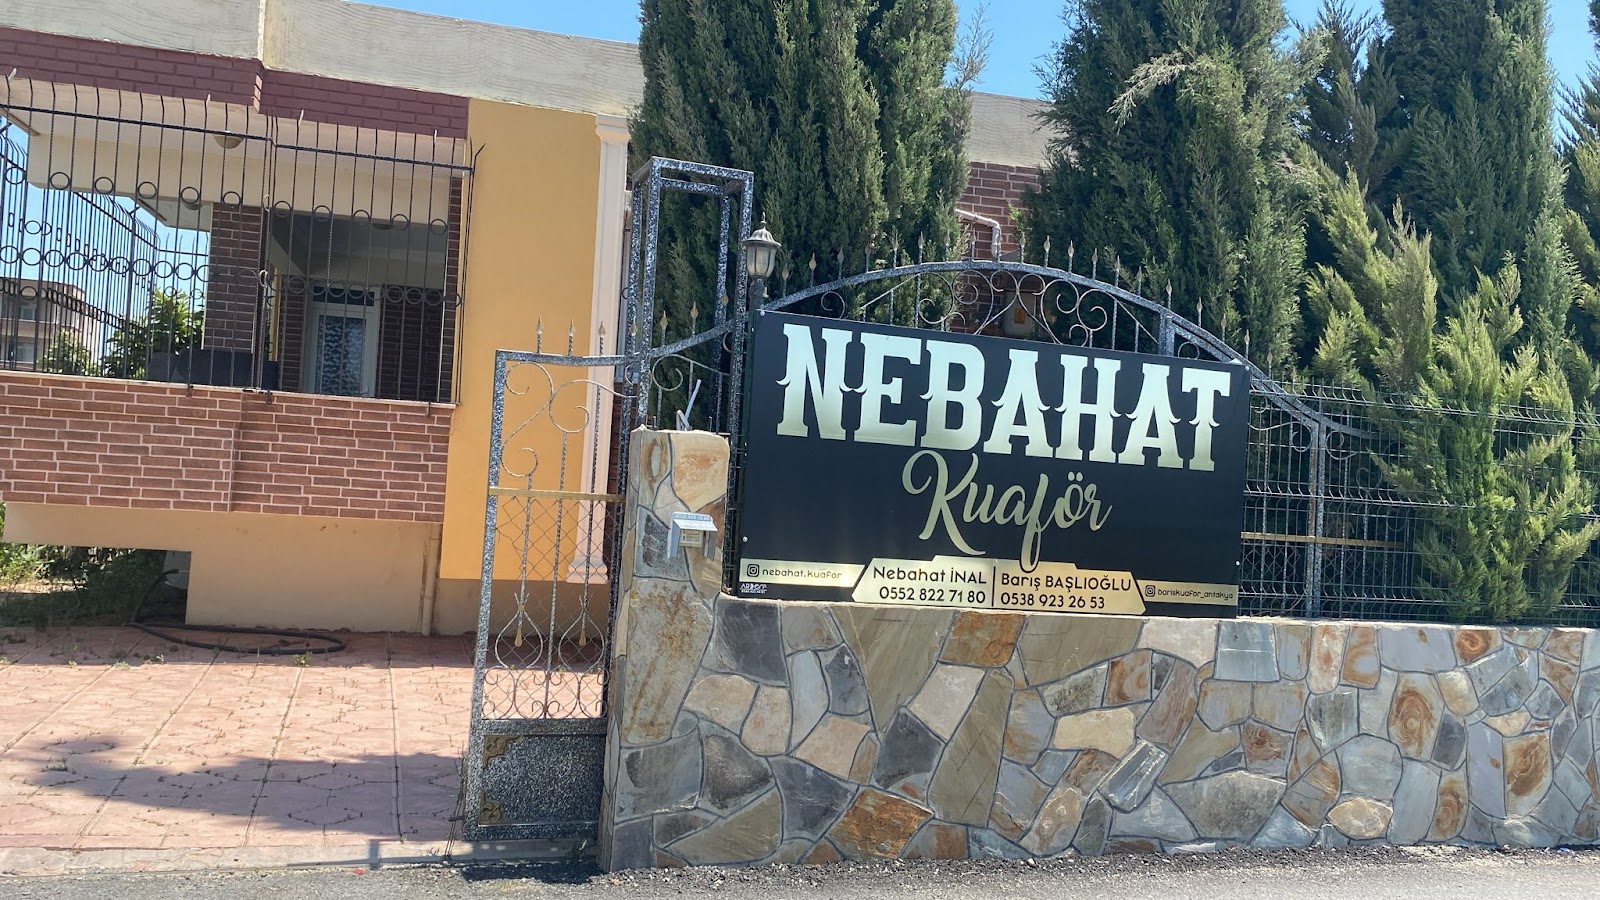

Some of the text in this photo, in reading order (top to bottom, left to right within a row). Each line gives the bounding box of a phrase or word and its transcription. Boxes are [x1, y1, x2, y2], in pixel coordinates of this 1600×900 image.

[776, 323, 1231, 471] NEBAHAT
[902, 449, 1113, 573] Kuaför
[762, 568, 842, 579] nebahat.kuafor
[873, 566, 987, 585] Nebahat İNAL
[1001, 573, 1132, 593] Barış BAŞLIOĞLU
[879, 586, 986, 604] 0552 822 71 80
[1001, 592, 1105, 609] 0538 923 26 53
[1157, 588, 1233, 601] bariskuafor_antakya
